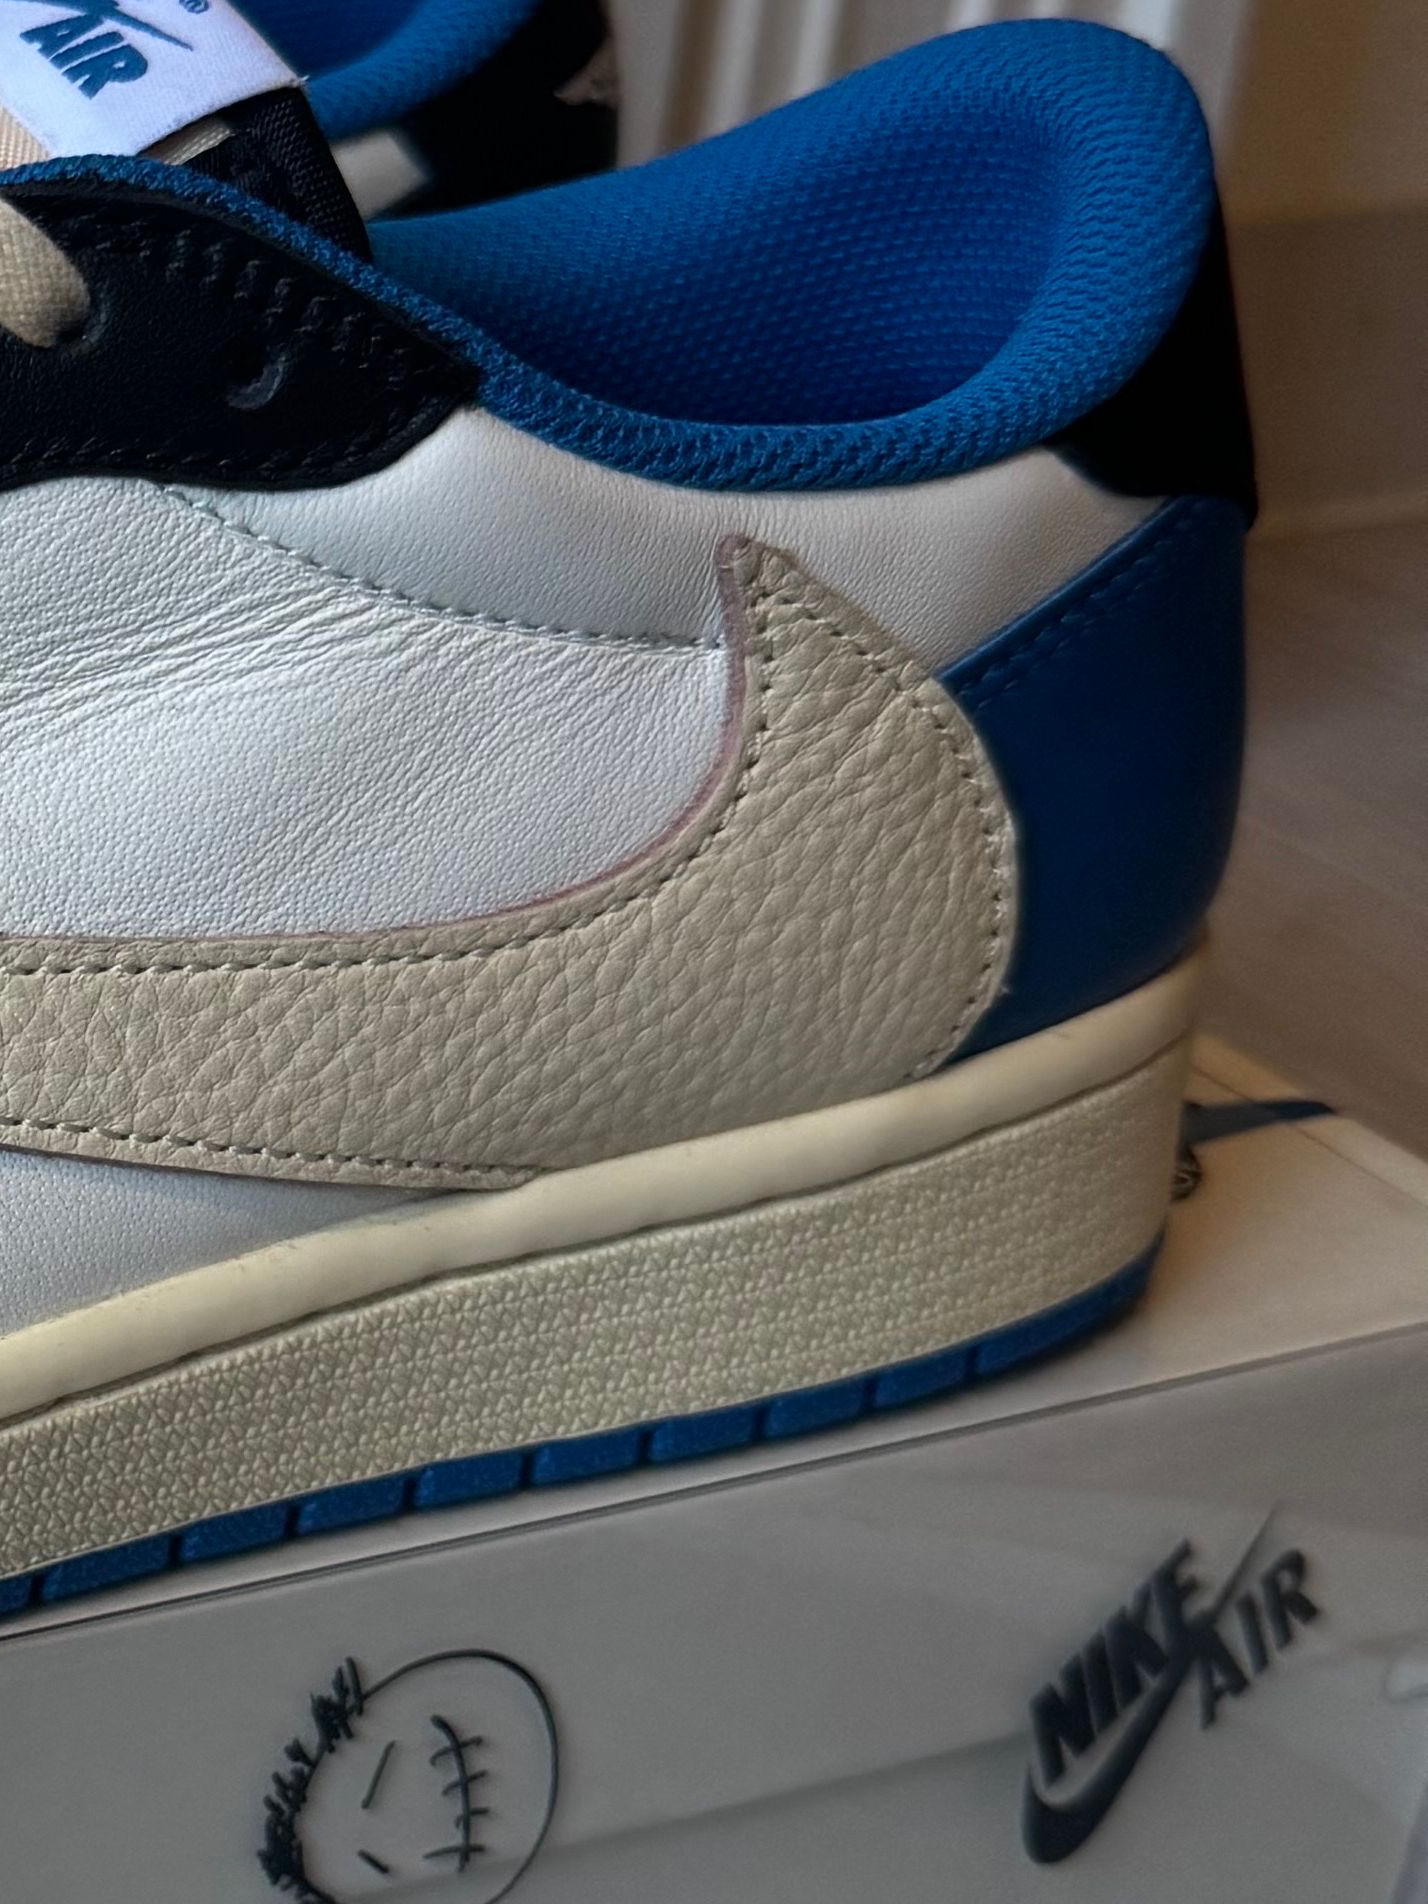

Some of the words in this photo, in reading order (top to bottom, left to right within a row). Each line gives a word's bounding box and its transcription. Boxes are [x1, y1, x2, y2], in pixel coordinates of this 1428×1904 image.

[19, 13, 149, 100] AIR
[1028, 1537, 1200, 1790] NIKE
[1190, 1549, 1321, 1731] AIR
